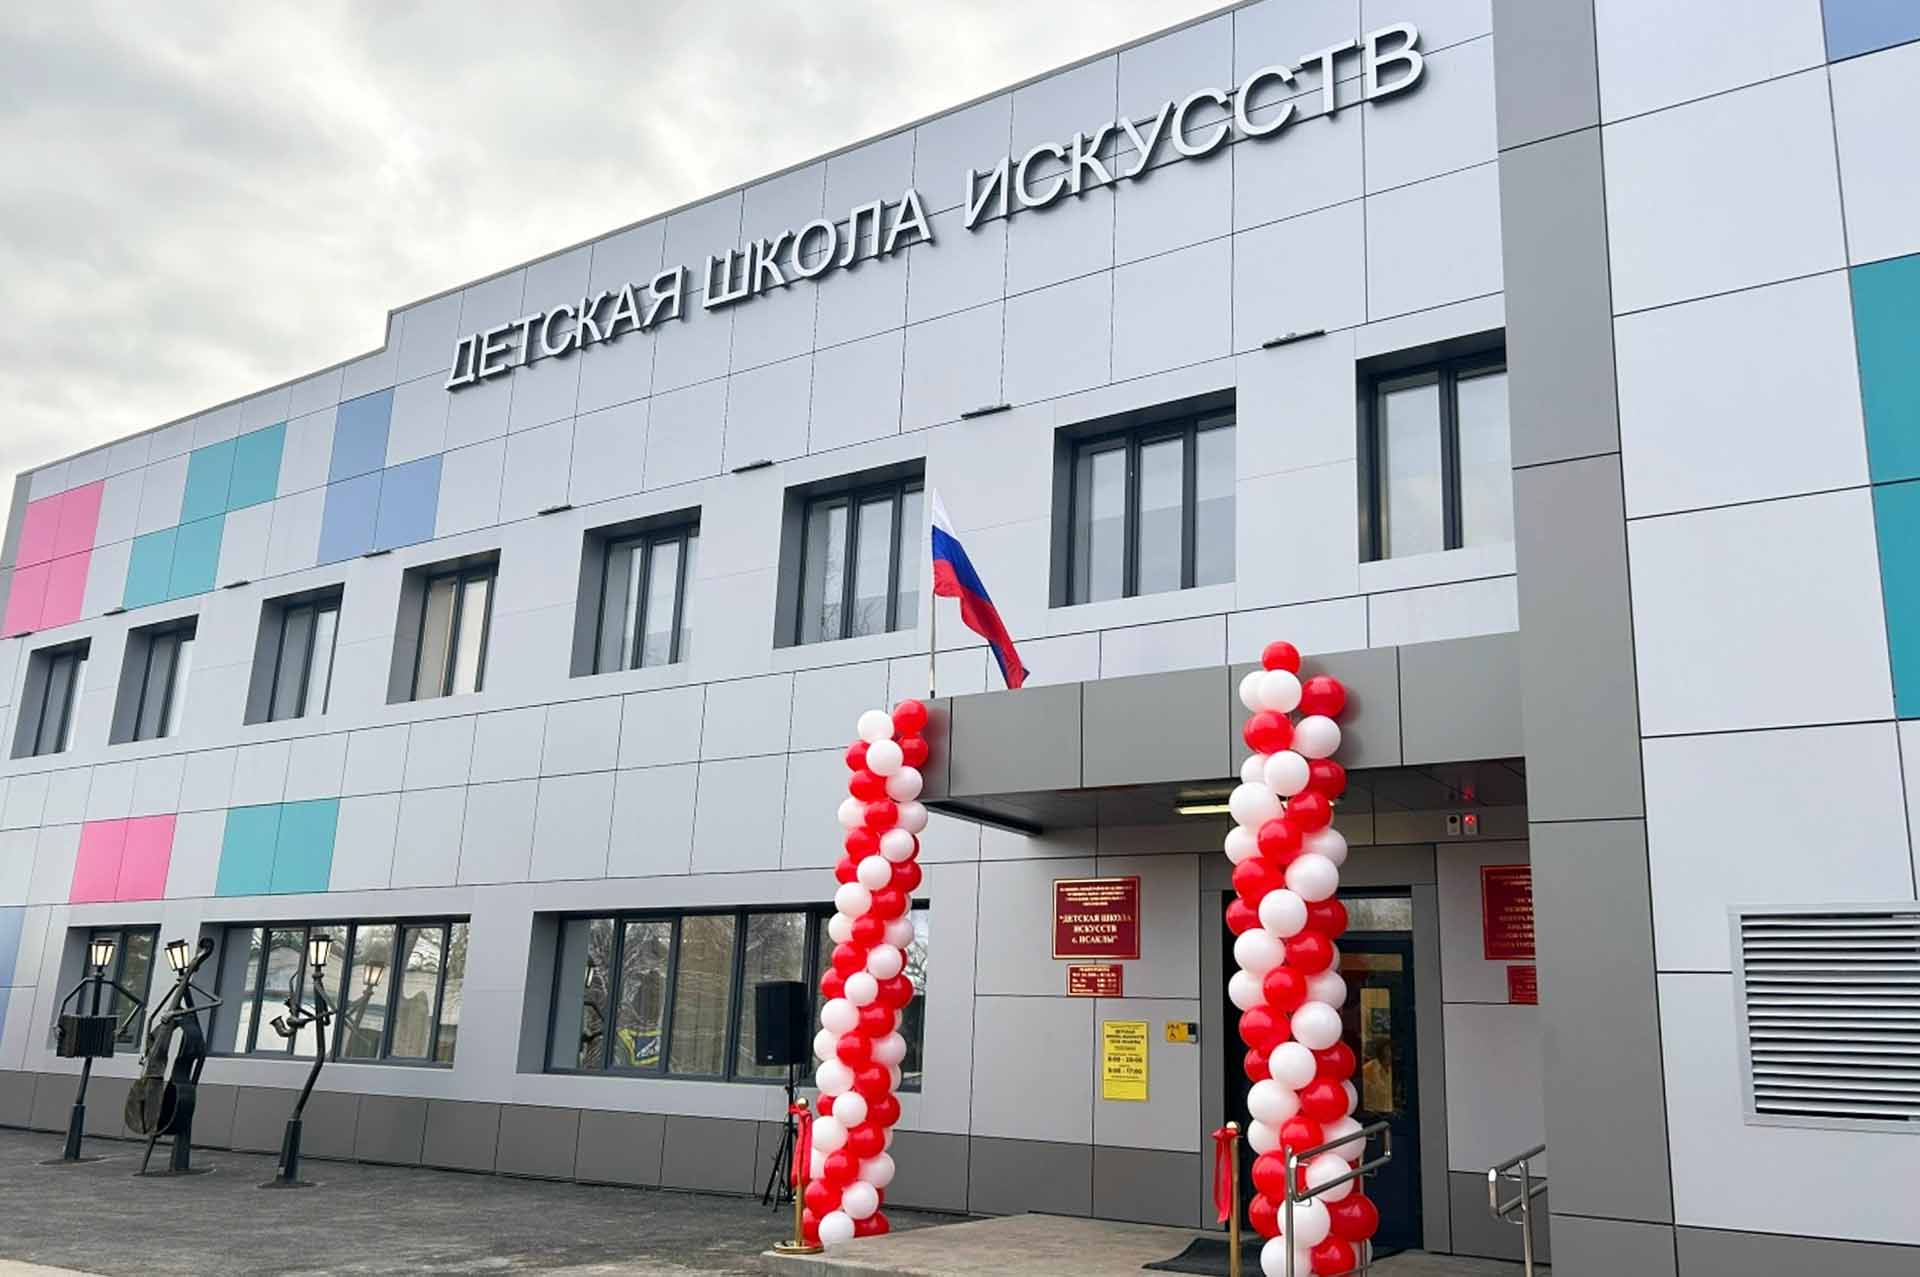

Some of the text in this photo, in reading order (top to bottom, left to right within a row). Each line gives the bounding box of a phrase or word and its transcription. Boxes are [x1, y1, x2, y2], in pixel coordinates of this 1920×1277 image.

[445, 21, 1425, 391] ДЕТСКАЯ ШКОЛА ИСКУССТВ
